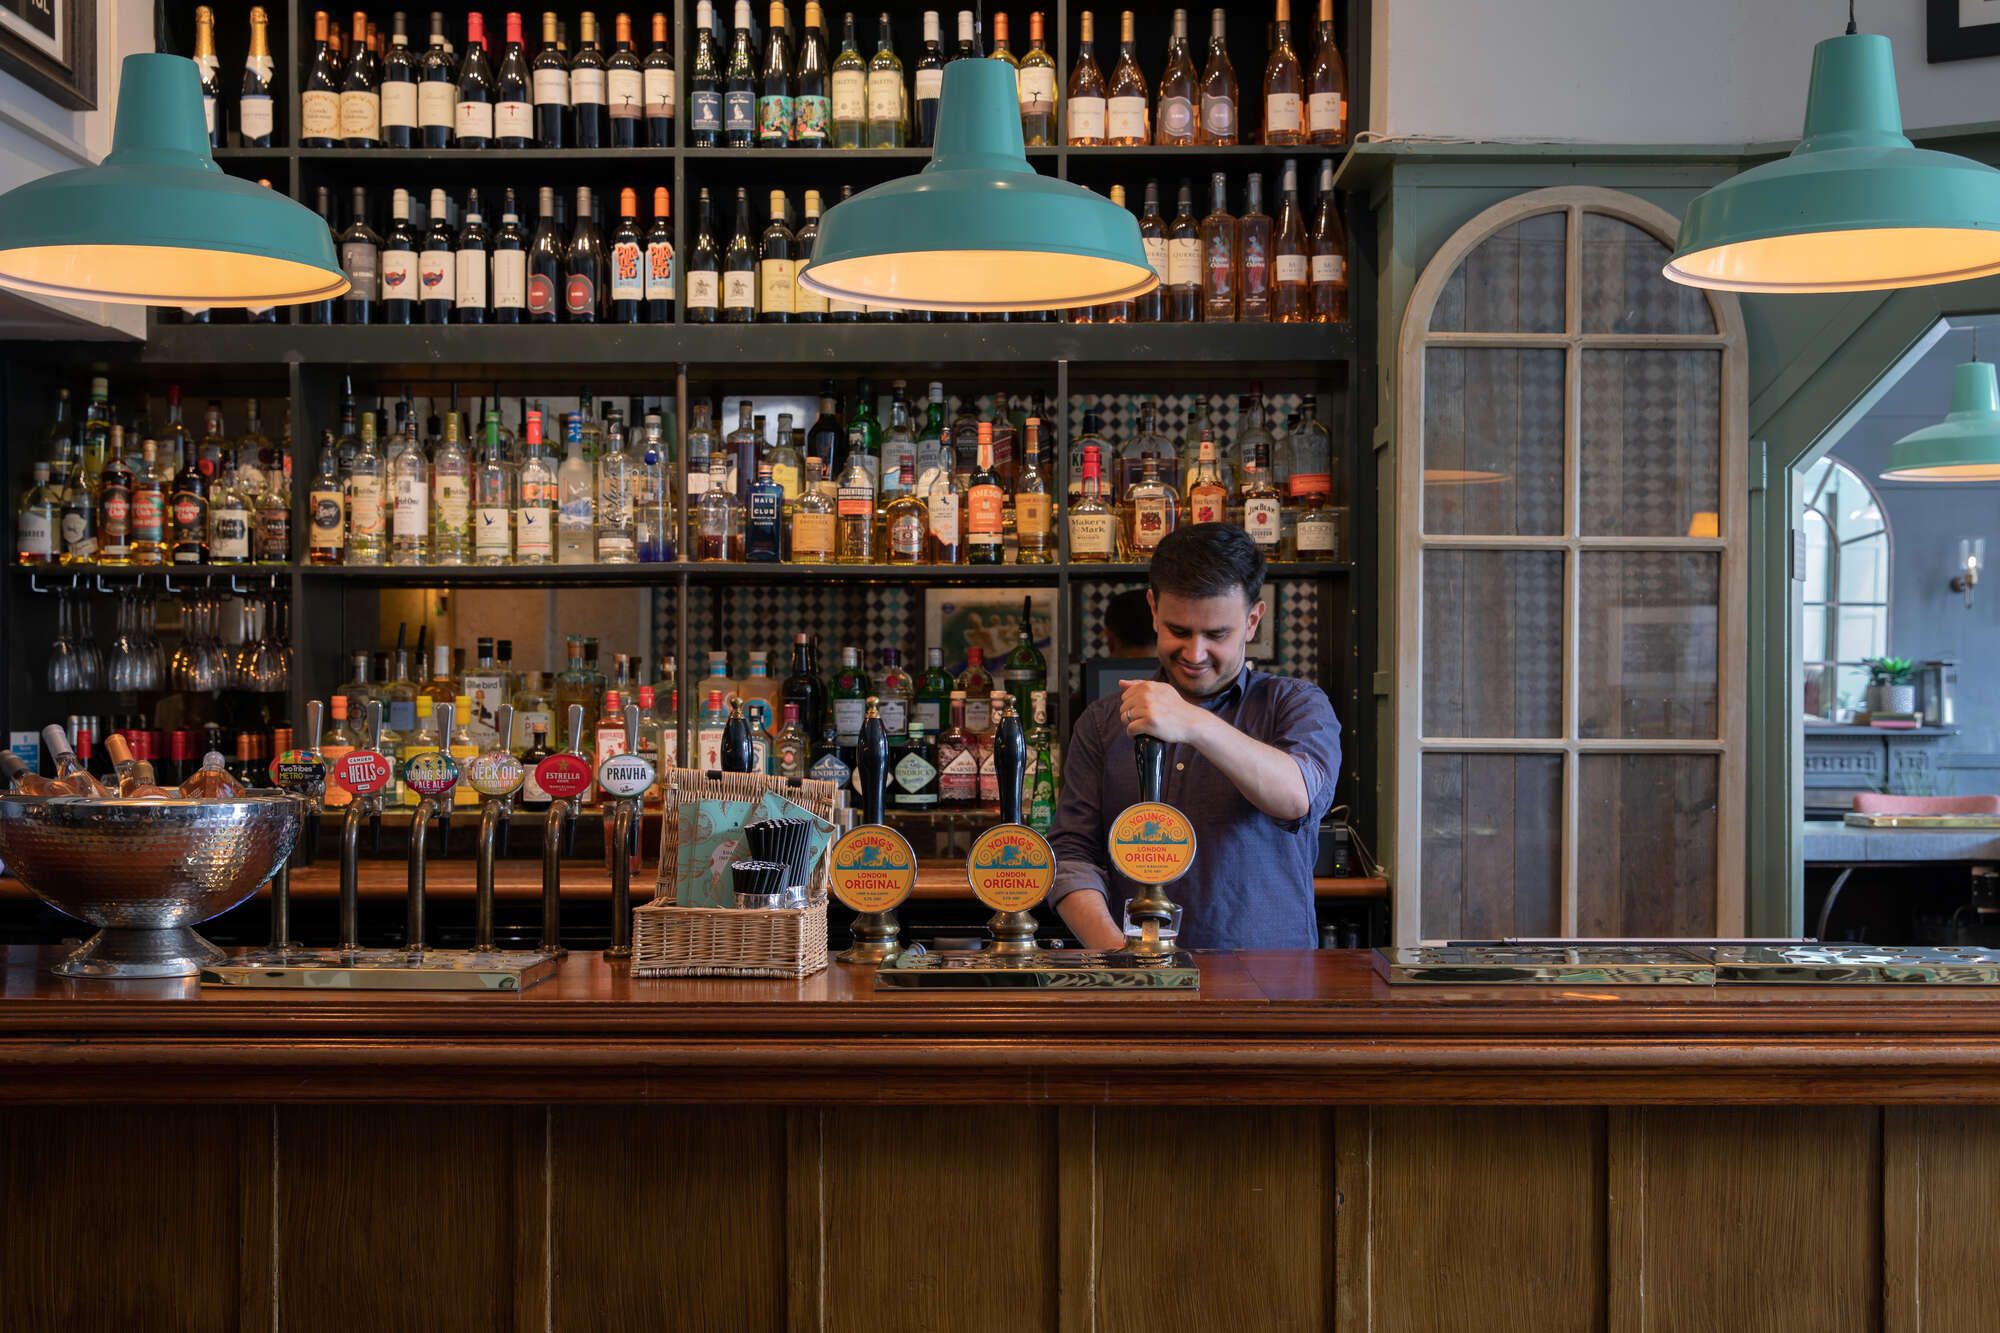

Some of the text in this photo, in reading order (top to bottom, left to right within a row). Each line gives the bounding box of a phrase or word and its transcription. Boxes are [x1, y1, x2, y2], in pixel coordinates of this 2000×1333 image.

[1080, 525, 1105, 533] Mark
[280, 772, 303, 780] METRO
[348, 763, 376, 784] HELLS
[437, 769, 453, 780] SUN
[472, 765, 518, 780] NECK OIL
[546, 772, 580, 780] ESTRELLA
[607, 767, 647, 780] PRAVHA
[414, 781, 430, 789] PALE
[1130, 812, 1175, 827] YOUNG'S
[848, 836, 895, 852] YOUNG'S
[987, 835, 1034, 851] YOUNG'S
[1125, 853, 1180, 863] ORIGINAL
[845, 879, 901, 890] ORIGINAL
[983, 878, 1040, 889] ORIGINAL
